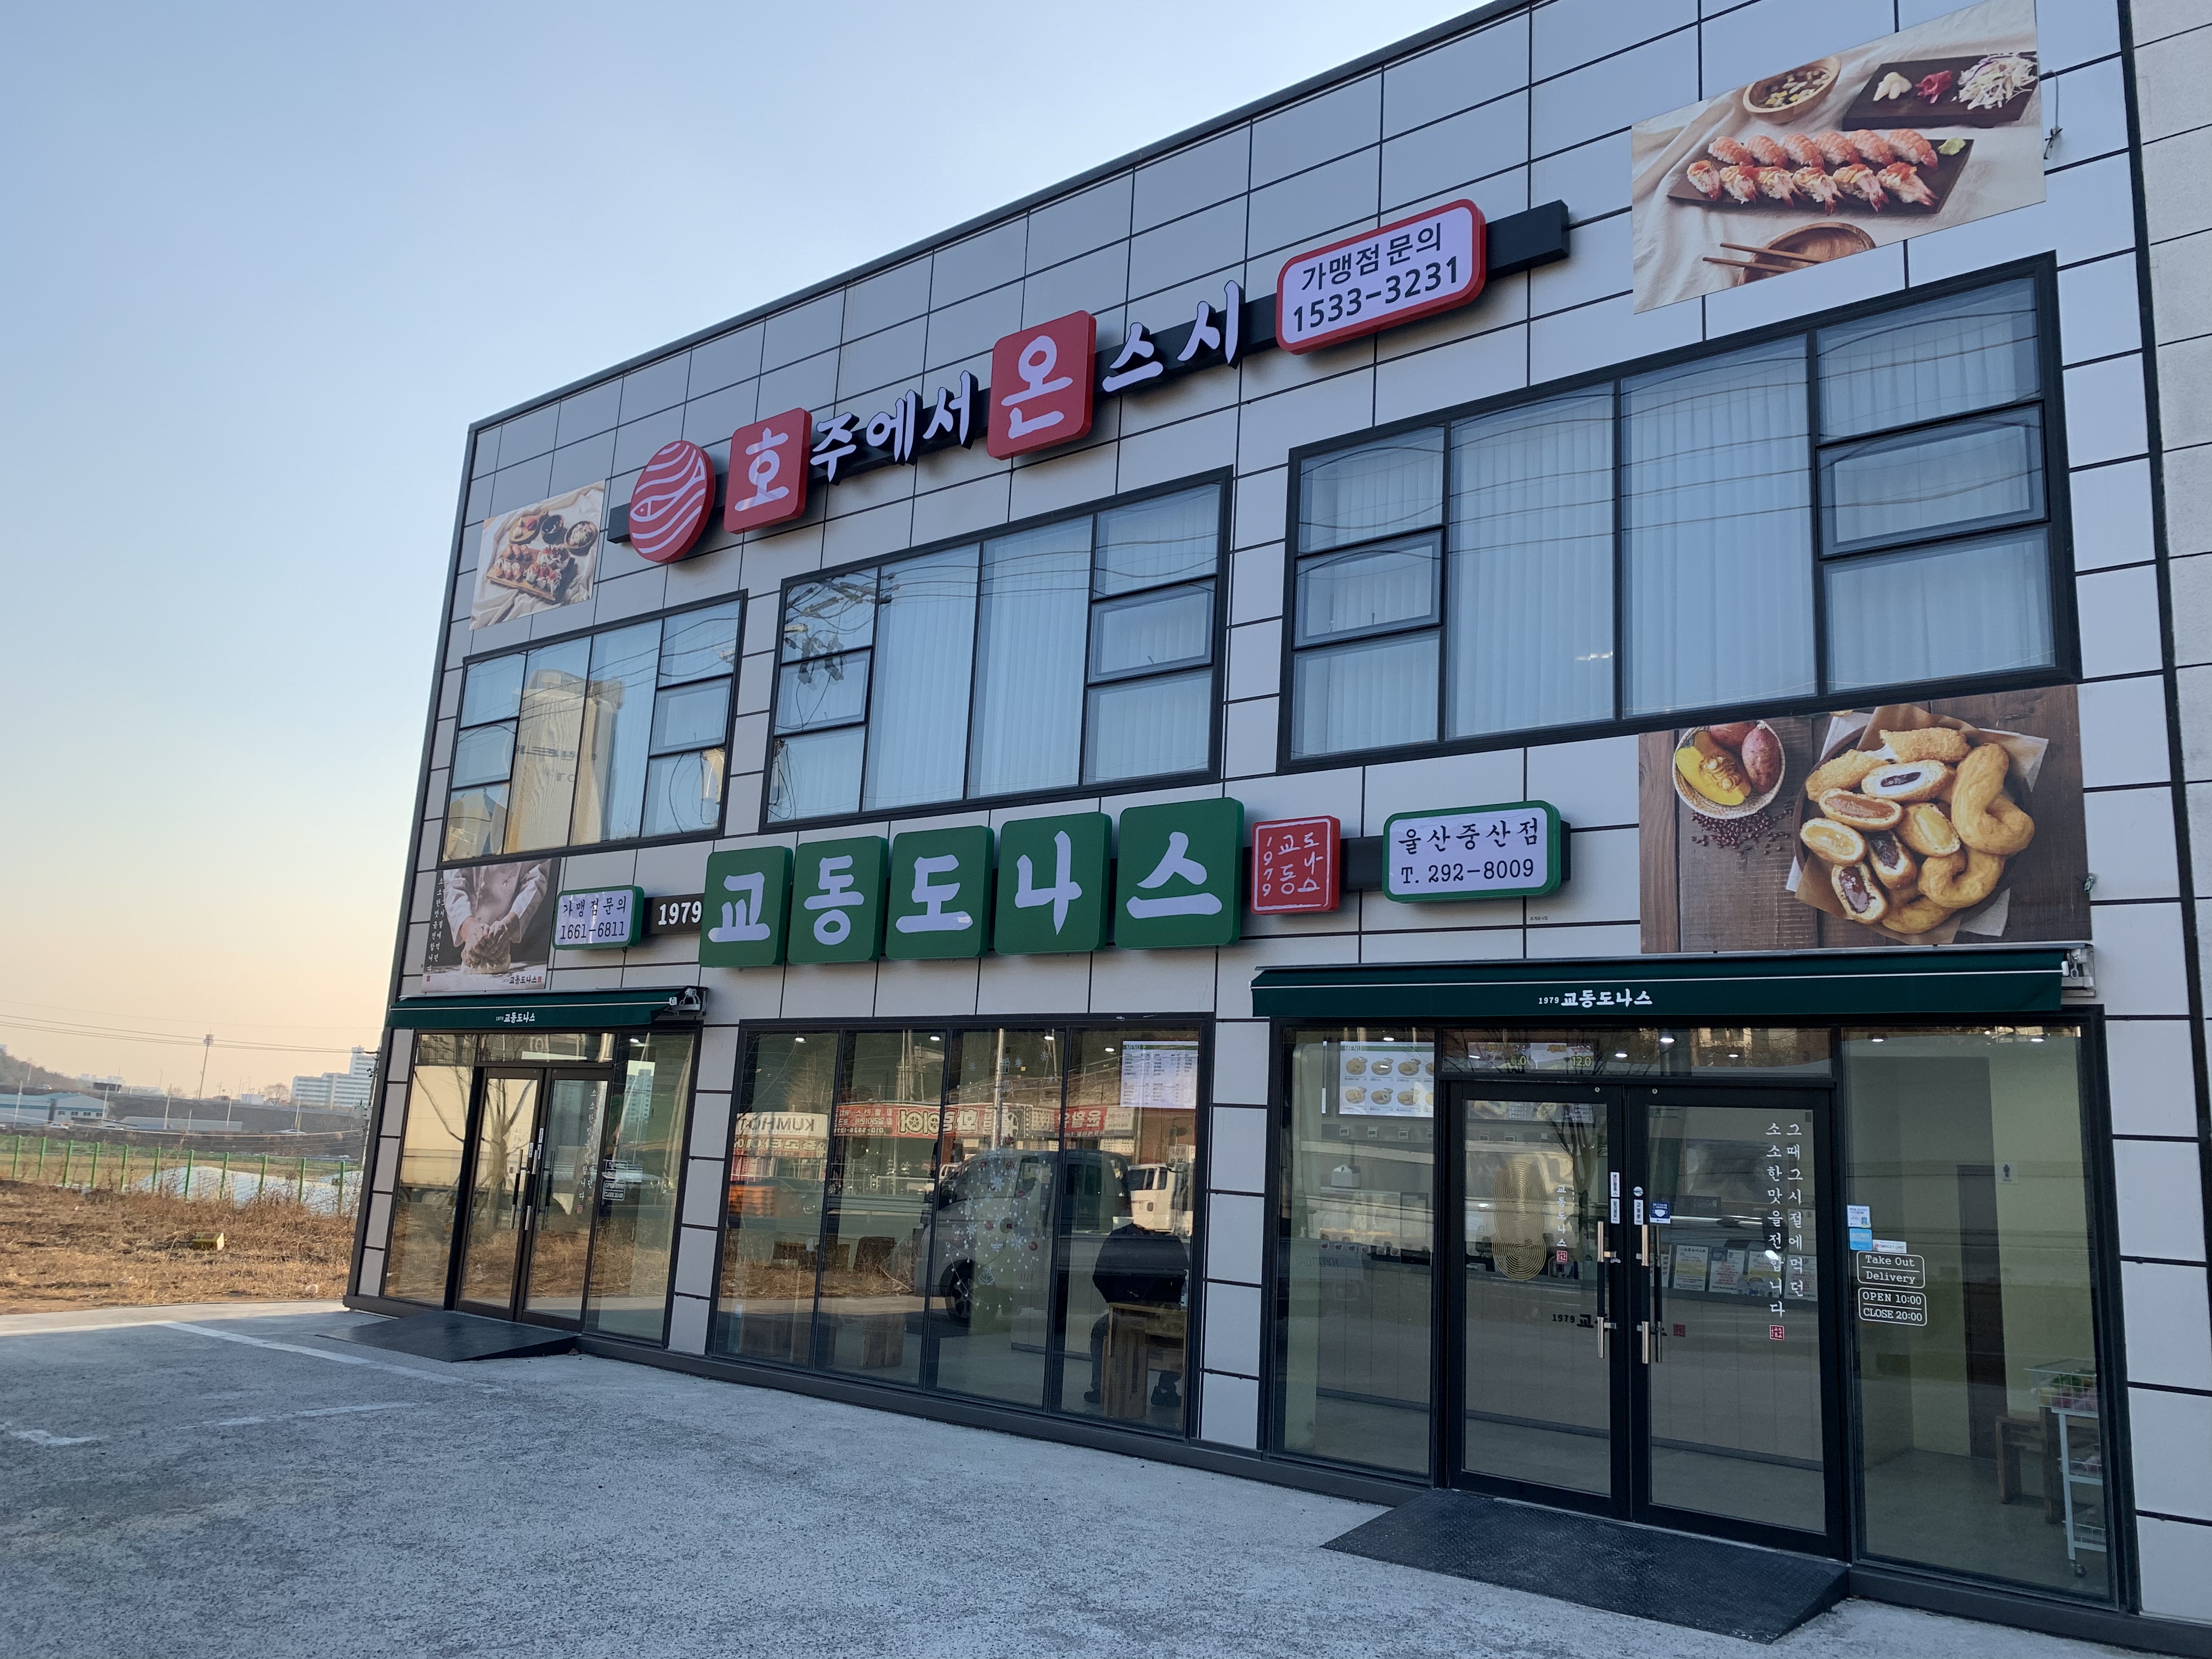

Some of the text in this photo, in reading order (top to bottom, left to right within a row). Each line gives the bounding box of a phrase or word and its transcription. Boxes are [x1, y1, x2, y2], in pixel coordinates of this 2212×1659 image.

[1301, 222, 1441, 291] 가맹점 문의
[1293, 256, 1458, 332] 1533-3231
[1102, 279, 1242, 393] 스시
[1397, 817, 1538, 854] 울산중산점
[658, 831, 1223, 946] 1979 교동도나스
[560, 921, 625, 939] 1661-6811
[509, 974, 537, 985] 교동도나스
[1561, 988, 1653, 1008] 교동도나스
[504, 1011, 535, 1024] 교동도나스
[1571, 1056, 1592, 1067] 12.0
[1556, 1184, 1567, 1247] 교동도나스
[1865, 1255, 1915, 1267] Take Out
[1866, 1271, 1916, 1284] Delivery
[1863, 1291, 1922, 1305] OPEN 10:00
[1552, 1313, 1575, 1323] 1979
[1863, 1307, 1922, 1322] CLOSE 20:00
